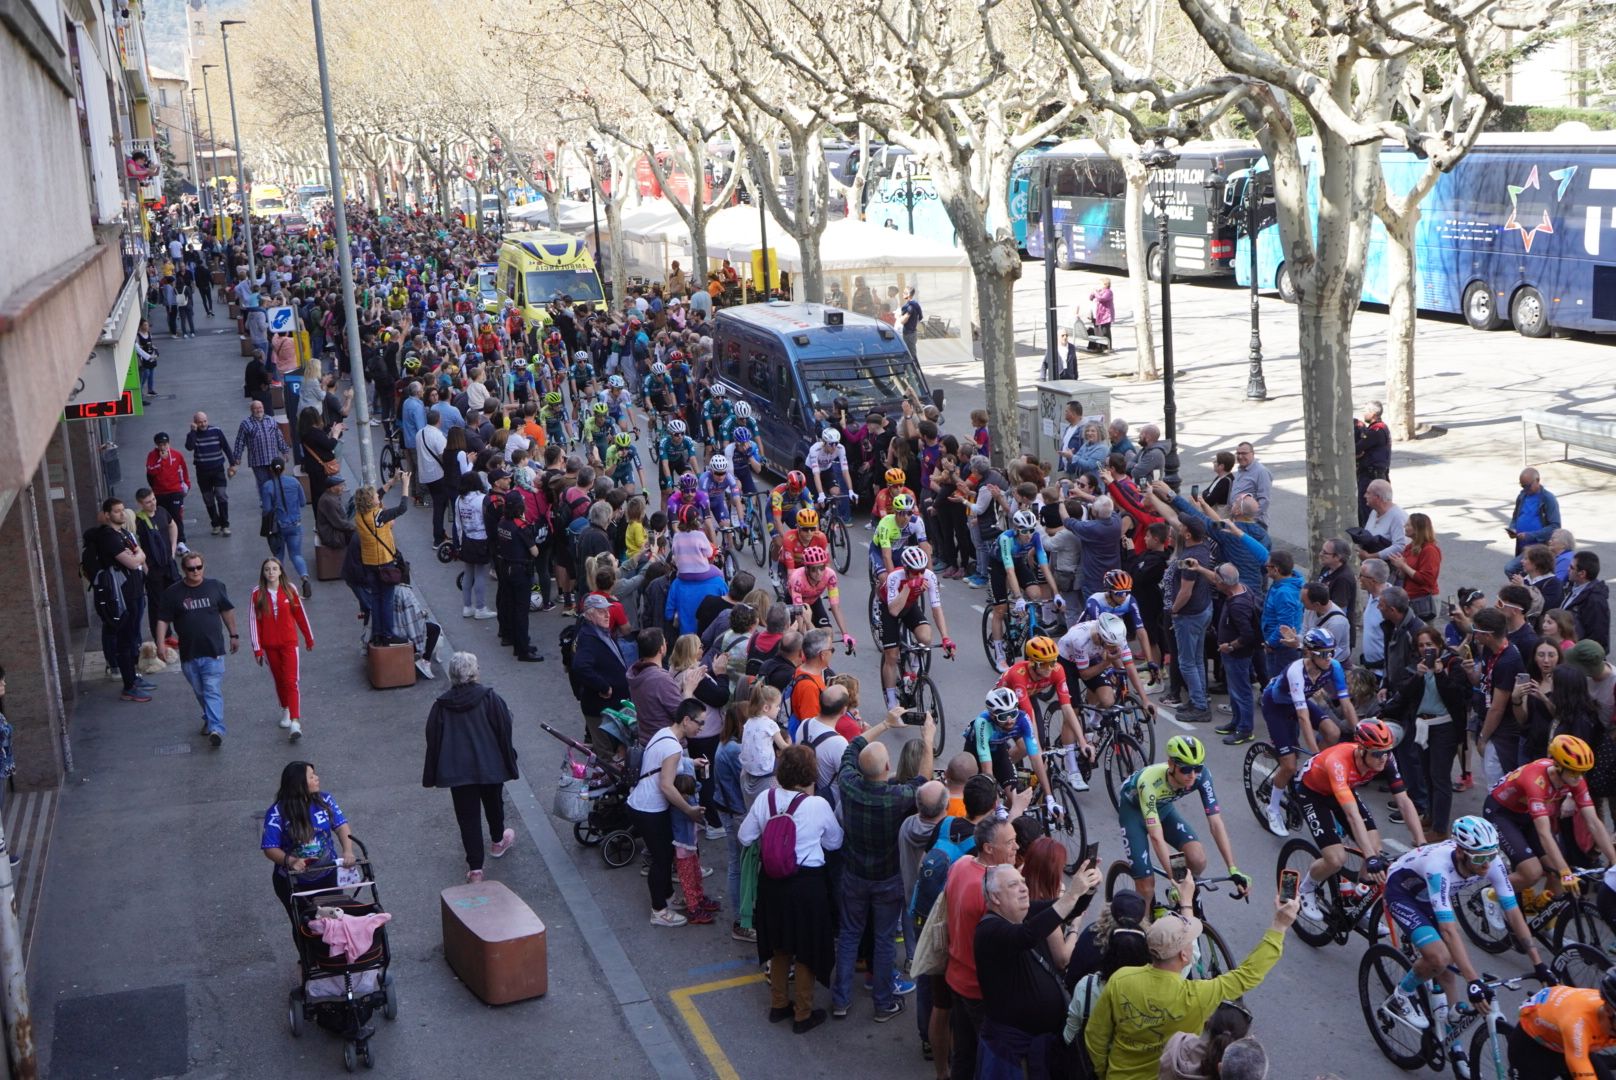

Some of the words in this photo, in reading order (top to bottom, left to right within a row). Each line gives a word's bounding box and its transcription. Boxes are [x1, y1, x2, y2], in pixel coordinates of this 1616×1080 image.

[292, 382, 301, 393] P
[1202, 780, 1217, 805] BORA
[1303, 803, 1325, 838] INEOS
